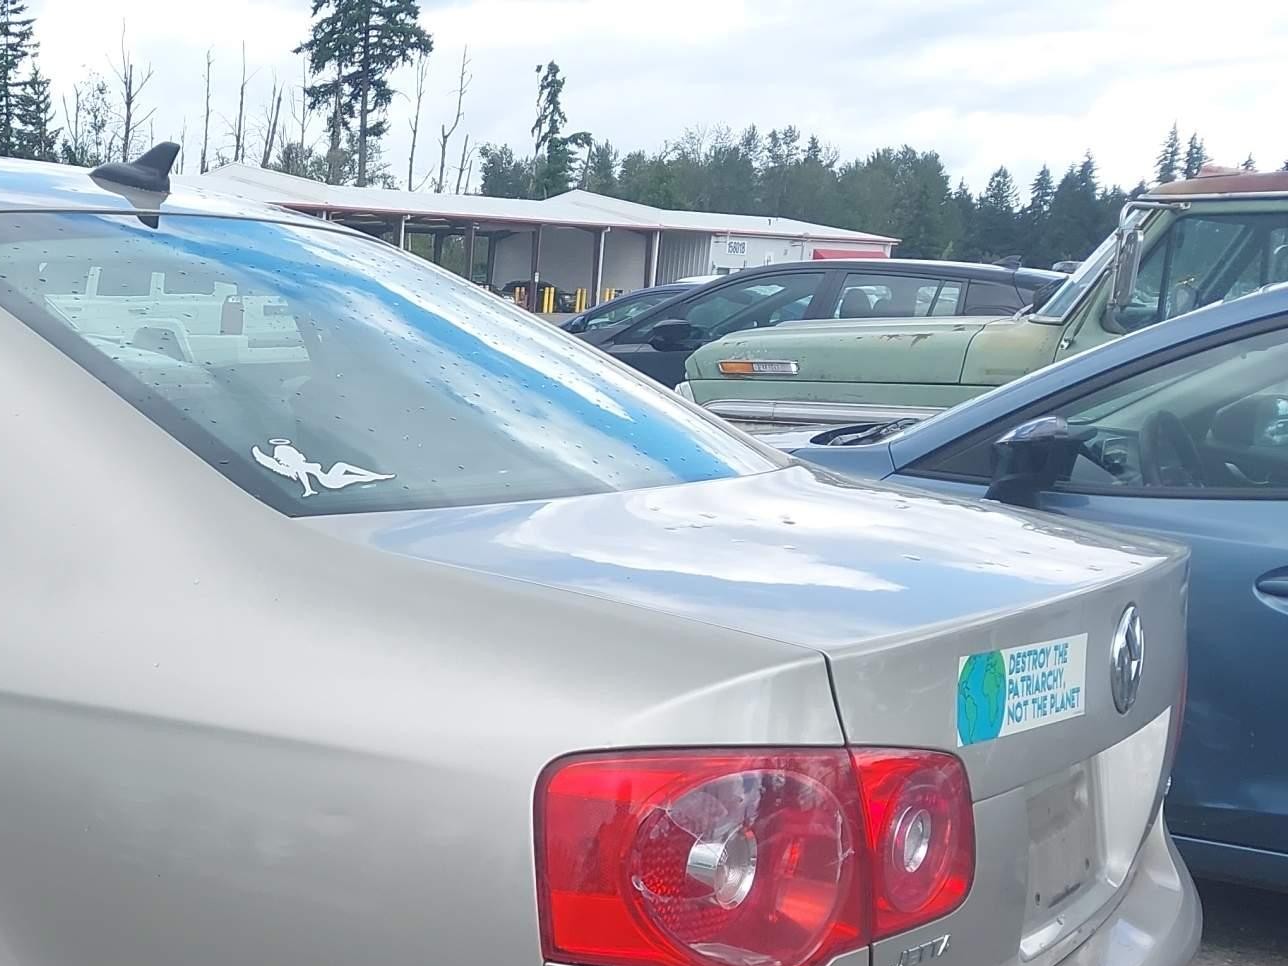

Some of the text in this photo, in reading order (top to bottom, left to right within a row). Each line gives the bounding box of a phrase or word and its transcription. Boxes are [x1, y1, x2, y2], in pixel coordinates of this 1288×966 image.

[1008, 643, 1069, 676] DESTROY THE
[1008, 668, 1066, 700] PATRIARCHY,
[1008, 687, 1081, 725] NOT THE PLANET
